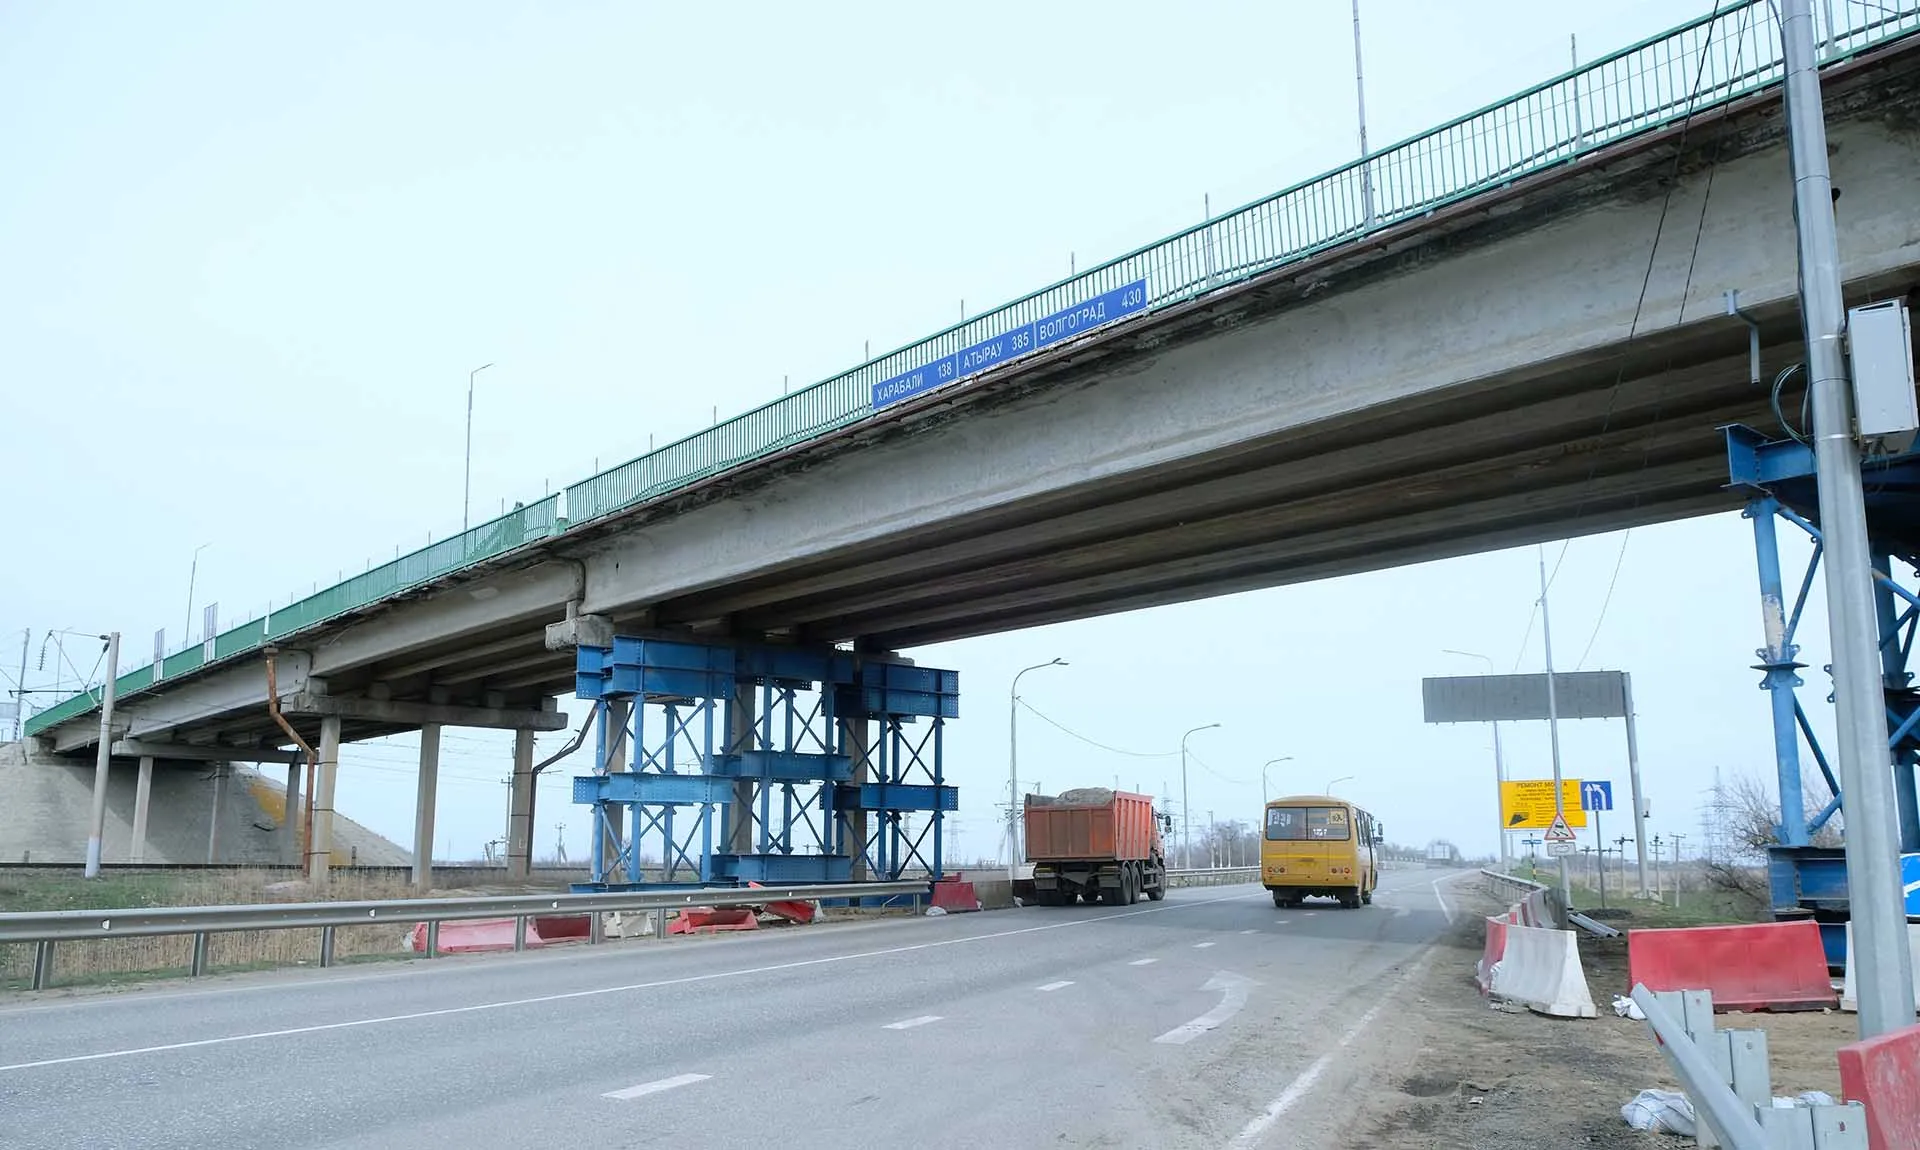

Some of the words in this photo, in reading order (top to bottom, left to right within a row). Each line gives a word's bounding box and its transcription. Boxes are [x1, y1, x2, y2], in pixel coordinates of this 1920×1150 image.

[1040, 301, 1106, 340] ВОЛГОГРАД
[1121, 287, 1142, 308] 430
[963, 341, 1003, 369] АТЫРАУ
[1012, 331, 1029, 351] 385
[877, 372, 923, 401] ХАРАБАЛИ
[938, 361, 952, 379] 138
